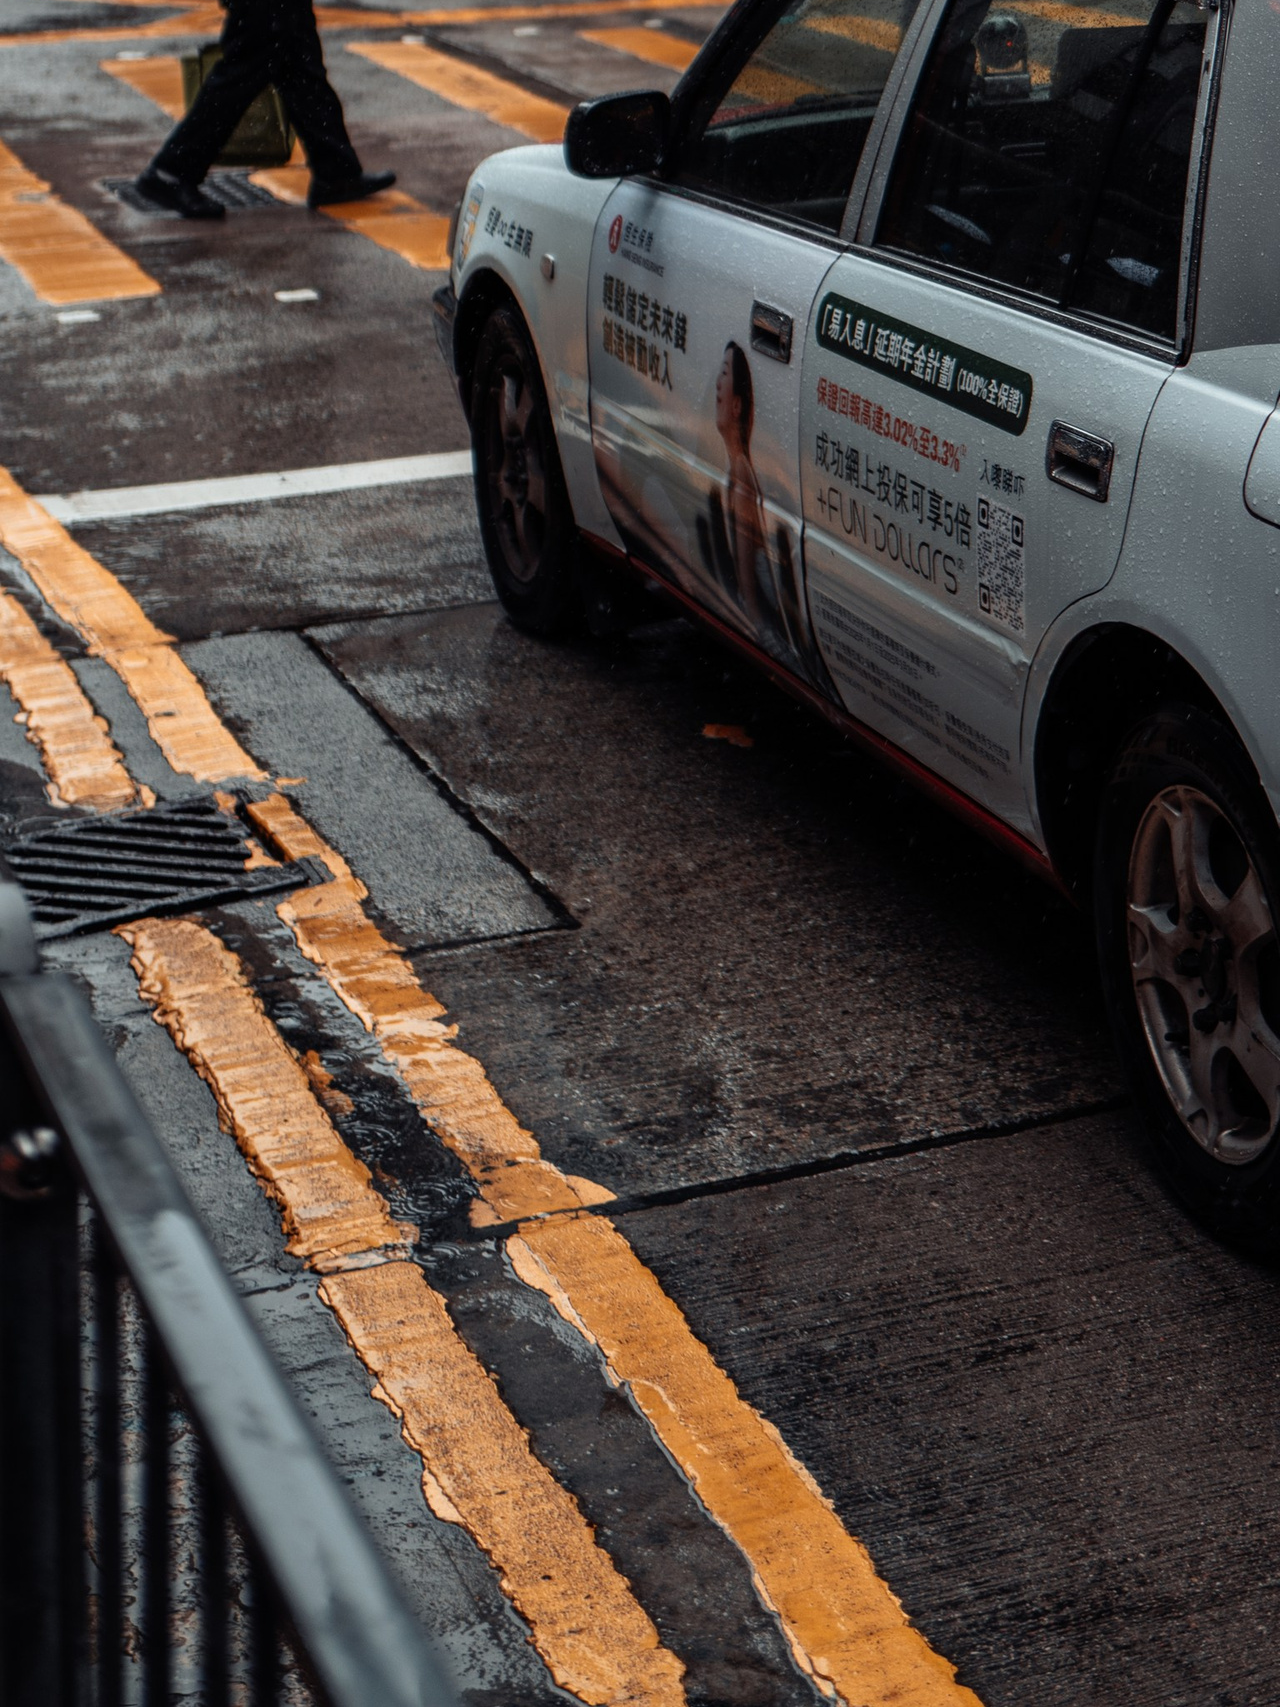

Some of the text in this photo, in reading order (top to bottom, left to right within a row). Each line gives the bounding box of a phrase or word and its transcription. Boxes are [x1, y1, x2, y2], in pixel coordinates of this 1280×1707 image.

[814, 429, 973, 552] 成功網上投保可享5倍
[816, 485, 868, 545] +FUN
